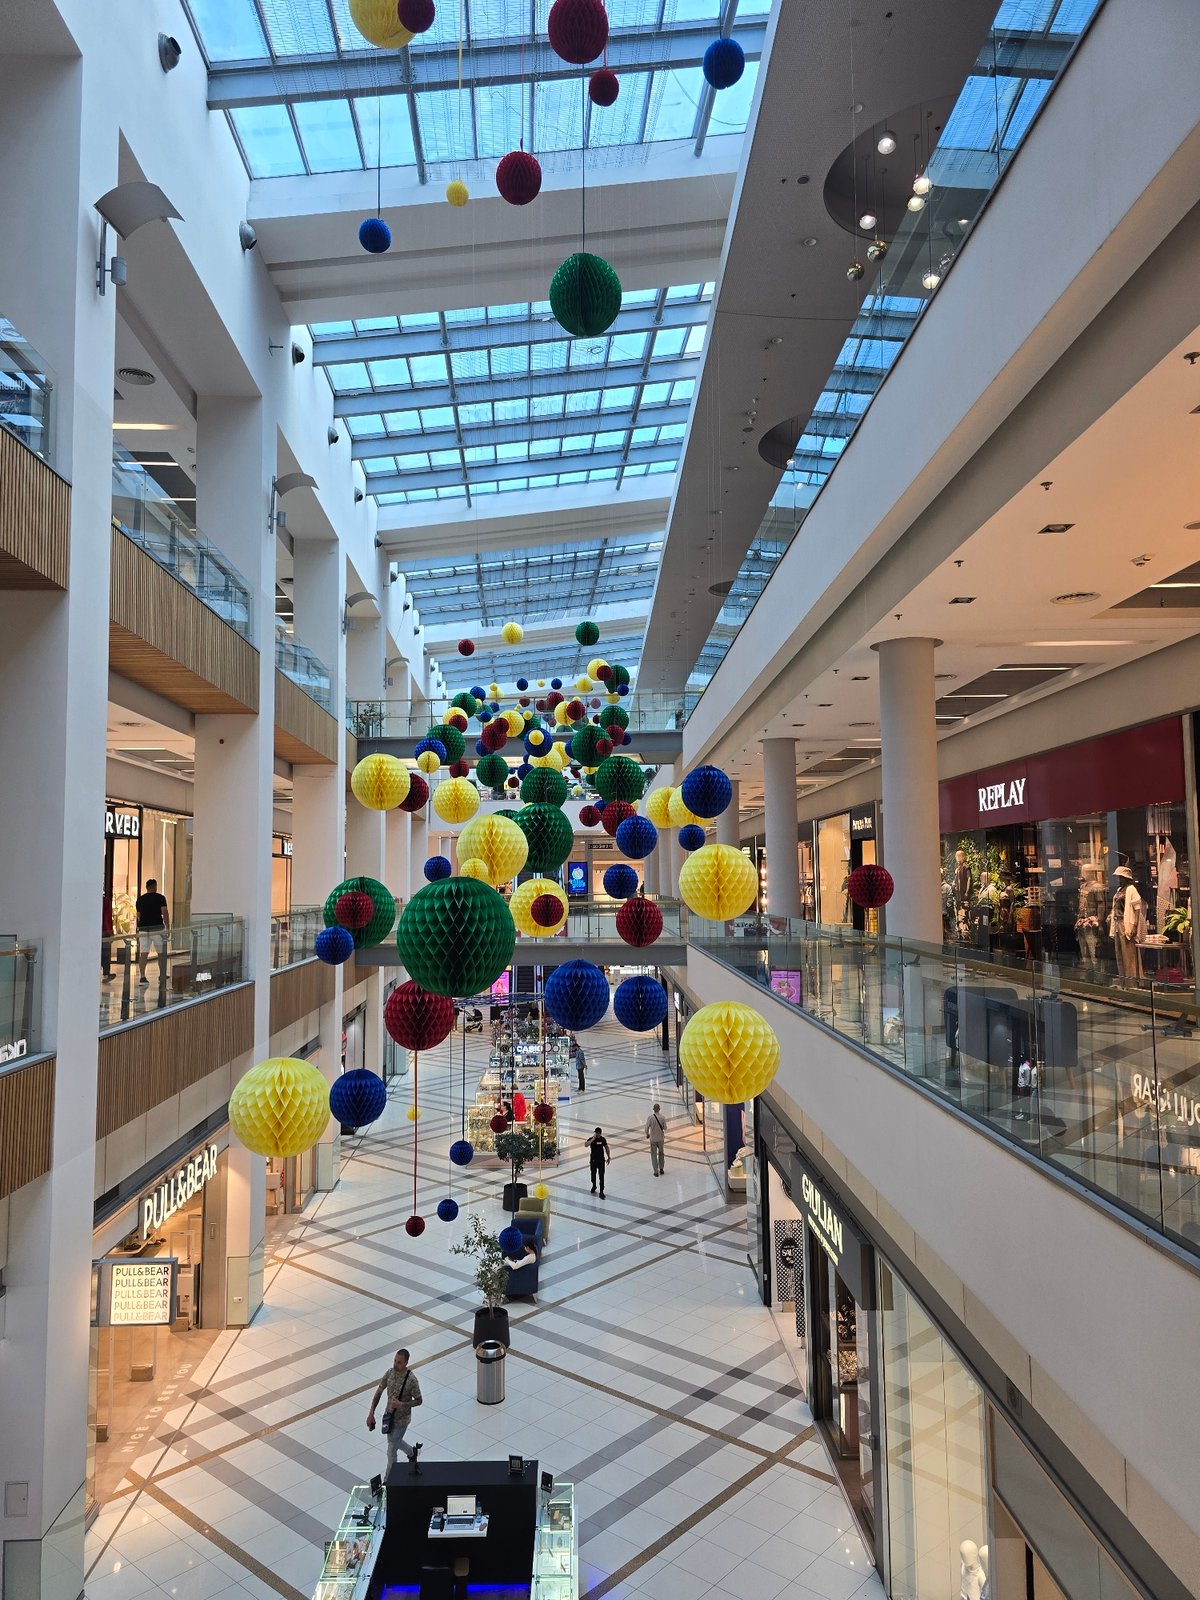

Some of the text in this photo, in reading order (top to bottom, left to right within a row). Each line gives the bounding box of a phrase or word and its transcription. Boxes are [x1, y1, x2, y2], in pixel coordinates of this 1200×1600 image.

[978, 778, 1027, 812] REPLAY
[143, 1144, 218, 1240] PULL&BEAR
[801, 1173, 843, 1254] GIULIAN
[115, 1266, 170, 1276] PULL&BEAR
[115, 1278, 169, 1287] PULL&BEAR
[114, 1289, 169, 1299] PULL&BEAR
[114, 1300, 168, 1310] PULL&BEAR
[113, 1312, 168, 1322] PULL&BEAR
